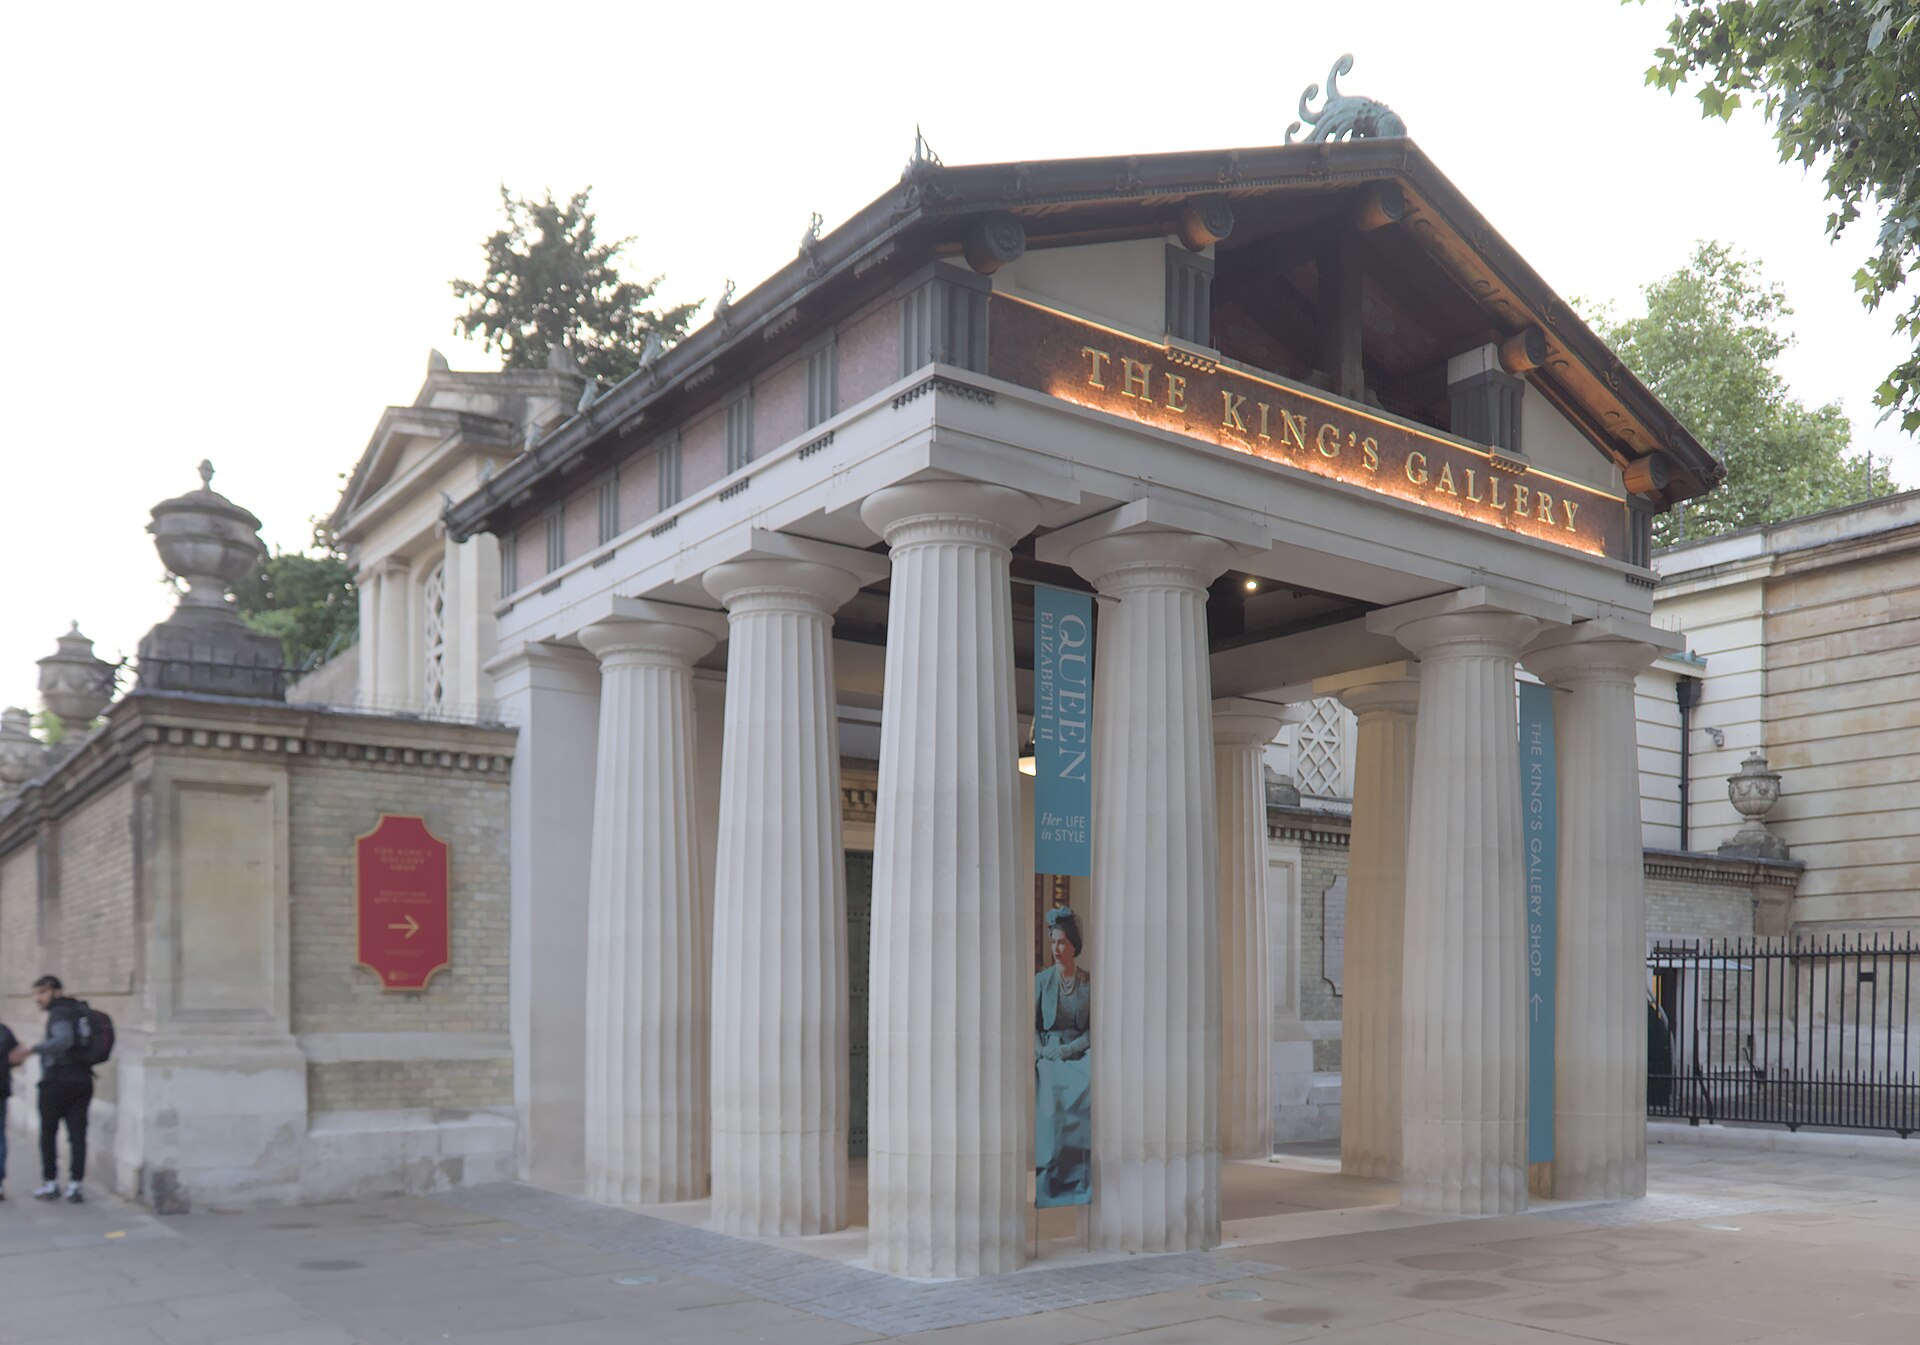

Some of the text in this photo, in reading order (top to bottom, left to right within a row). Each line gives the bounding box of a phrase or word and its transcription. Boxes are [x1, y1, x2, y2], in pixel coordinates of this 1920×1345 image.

[1081, 345, 1580, 532] THE KING'S GALLERY
[1041, 611, 1054, 741] ELIZABETH II
[1058, 614, 1087, 783] QUEEN
[1041, 811, 1086, 829] Her LIFE
[1041, 828, 1086, 843] in STYLE
[1530, 723, 1543, 977] THE KING'S GALLERY SHOP
